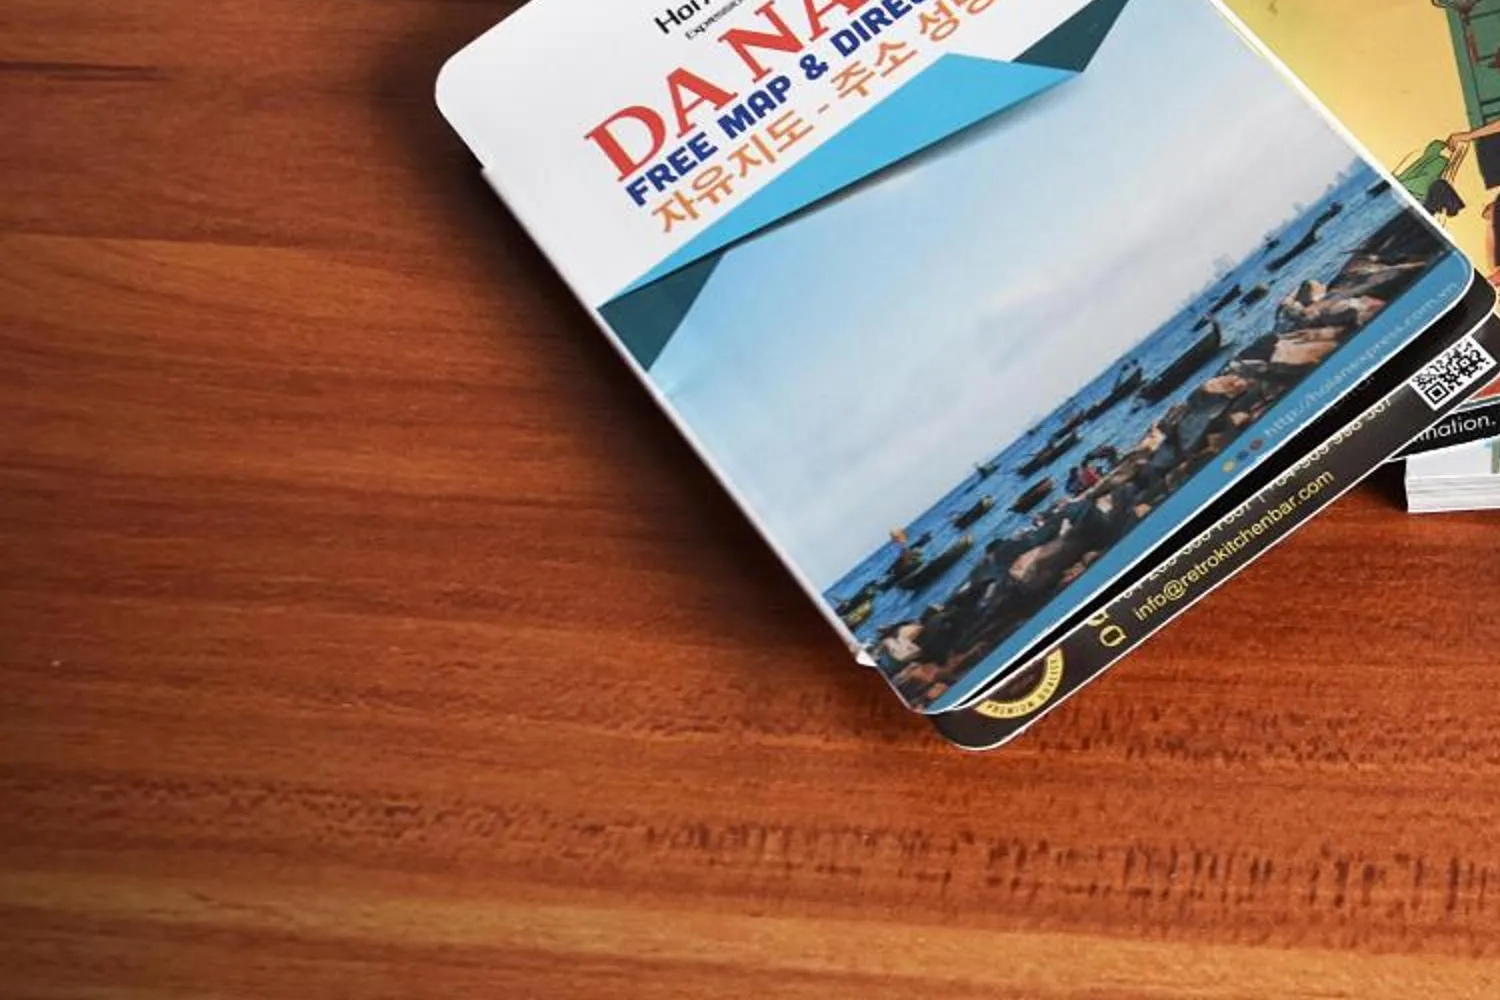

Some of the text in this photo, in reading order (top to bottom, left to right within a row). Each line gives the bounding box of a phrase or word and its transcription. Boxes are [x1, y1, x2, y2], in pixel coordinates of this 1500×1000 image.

[584, 67, 738, 183] DA
[625, 132, 720, 206] FREE
[717, 75, 792, 140] MAP
[800, 54, 828, 81] &
[651, 109, 814, 232] 자유지도
[832, 40, 919, 99] 주소
[1414, 414, 1497, 443] mation.
[1132, 468, 1335, 622] info@retrokitchenbar.com
